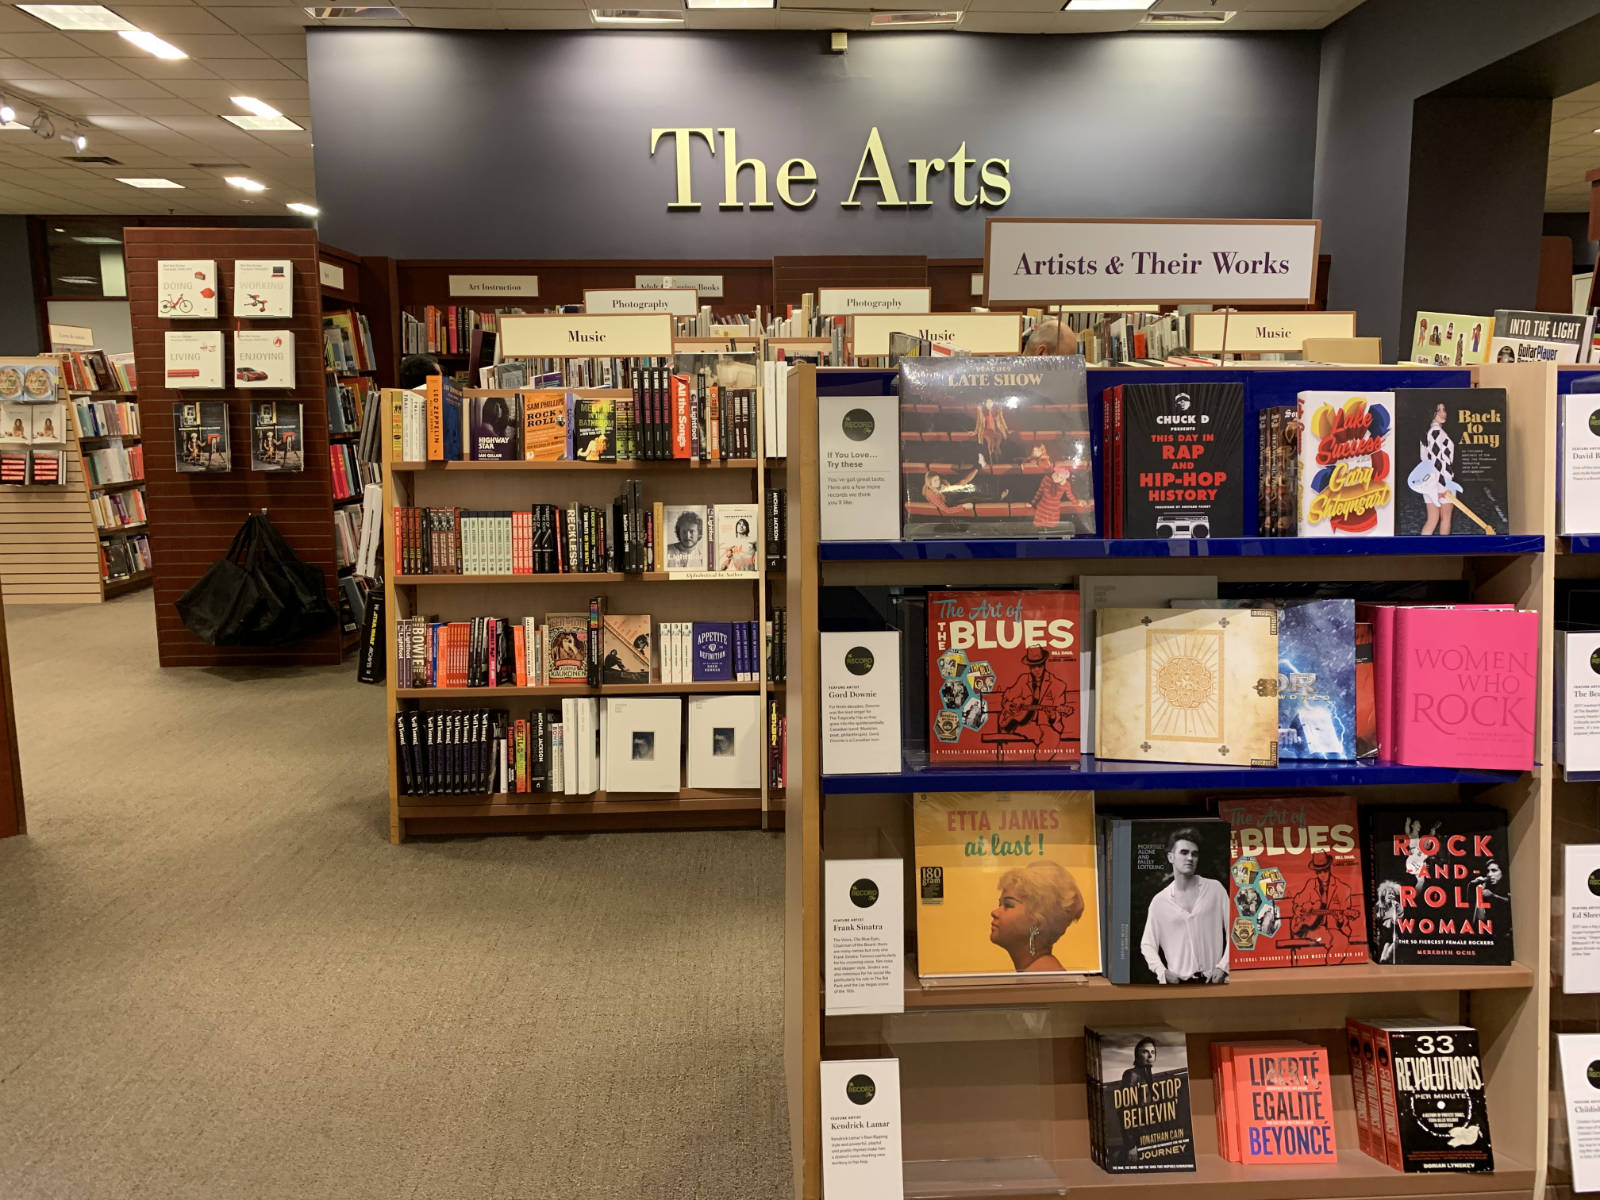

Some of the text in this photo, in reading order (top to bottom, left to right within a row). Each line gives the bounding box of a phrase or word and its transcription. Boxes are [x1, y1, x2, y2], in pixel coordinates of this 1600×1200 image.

[650, 126, 1011, 209] The Arts
[1013, 251, 1290, 276] Artists & Their Works
[163, 281, 193, 290] DOING
[239, 281, 284, 290] WORKING
[468, 283, 521, 291] Art Instruction
[698, 283, 720, 291] Books
[612, 299, 669, 310] Photography
[846, 298, 903, 309] Photography
[568, 330, 607, 343] Music
[918, 329, 956, 342] Music
[1255, 326, 1292, 339] Music
[1509, 318, 1581, 340] INTO THE LIGHT
[170, 353, 200, 361] LIVING
[239, 352, 284, 361] ENJOYING
[948, 373, 1043, 387] LATE SHOW
[526, 402, 540, 411] SAM
[527, 410, 557, 421] ROCK
[527, 418, 556, 428] ROLL
[677, 382, 687, 448] All the Songs
[690, 406, 698, 440] Lightfoot
[1156, 415, 1210, 424] CHUCK D
[1331, 407, 1374, 435] Lake
[1458, 409, 1502, 423] Back
[1467, 422, 1484, 434] to
[478, 436, 510, 444] HIGHWAY
[1151, 434, 1214, 442] THIS DAY IN
[1458, 432, 1500, 448] Amy
[1162, 444, 1205, 460] RAP
[1315, 435, 1386, 465] Success
[1572, 452, 1593, 460] David
[827, 460, 863, 469] Try these
[1172, 462, 1194, 470] AND
[1139, 472, 1227, 487] HIP-HOP
[1328, 462, 1374, 492] Gary
[1148, 489, 1218, 501] HISTORY
[1306, 486, 1392, 524] Shteyngart
[567, 509, 578, 566] RECKLESS
[934, 599, 1024, 624] The Art of
[698, 632, 728, 645] APPETITE
[937, 618, 1075, 651] THE BLUES
[412, 628, 424, 666] BOWIE
[1415, 645, 1537, 678] WOMEN
[1457, 673, 1520, 695] WHO
[1412, 692, 1534, 735] ROCK
[946, 809, 1060, 832] ETTA JAMES
[1223, 804, 1306, 829] The Art of
[991, 833, 1032, 856] last
[1240, 824, 1355, 857] BLUES
[1393, 834, 1494, 857] ROCK
[922, 868, 942, 879] 180
[922, 876, 942, 886] gram
[1400, 886, 1492, 909] ROLL
[834, 924, 855, 932] Frank
[1397, 918, 1493, 935] WOMAN
[1416, 1035, 1455, 1054] 33
[1394, 1056, 1482, 1092] REVOLUTIONS
[1114, 1078, 1182, 1109] DON'T STOP
[1123, 1098, 1178, 1130] BELIEVIN'
[831, 1120, 890, 1130] Kendrick Lamar
[1140, 1131, 1170, 1146] JONATHAN
[1170, 1128, 1184, 1141] CAIN
[1248, 1120, 1334, 1156] BEYONCÉ
[1139, 1144, 1187, 1160] JOURNEY
